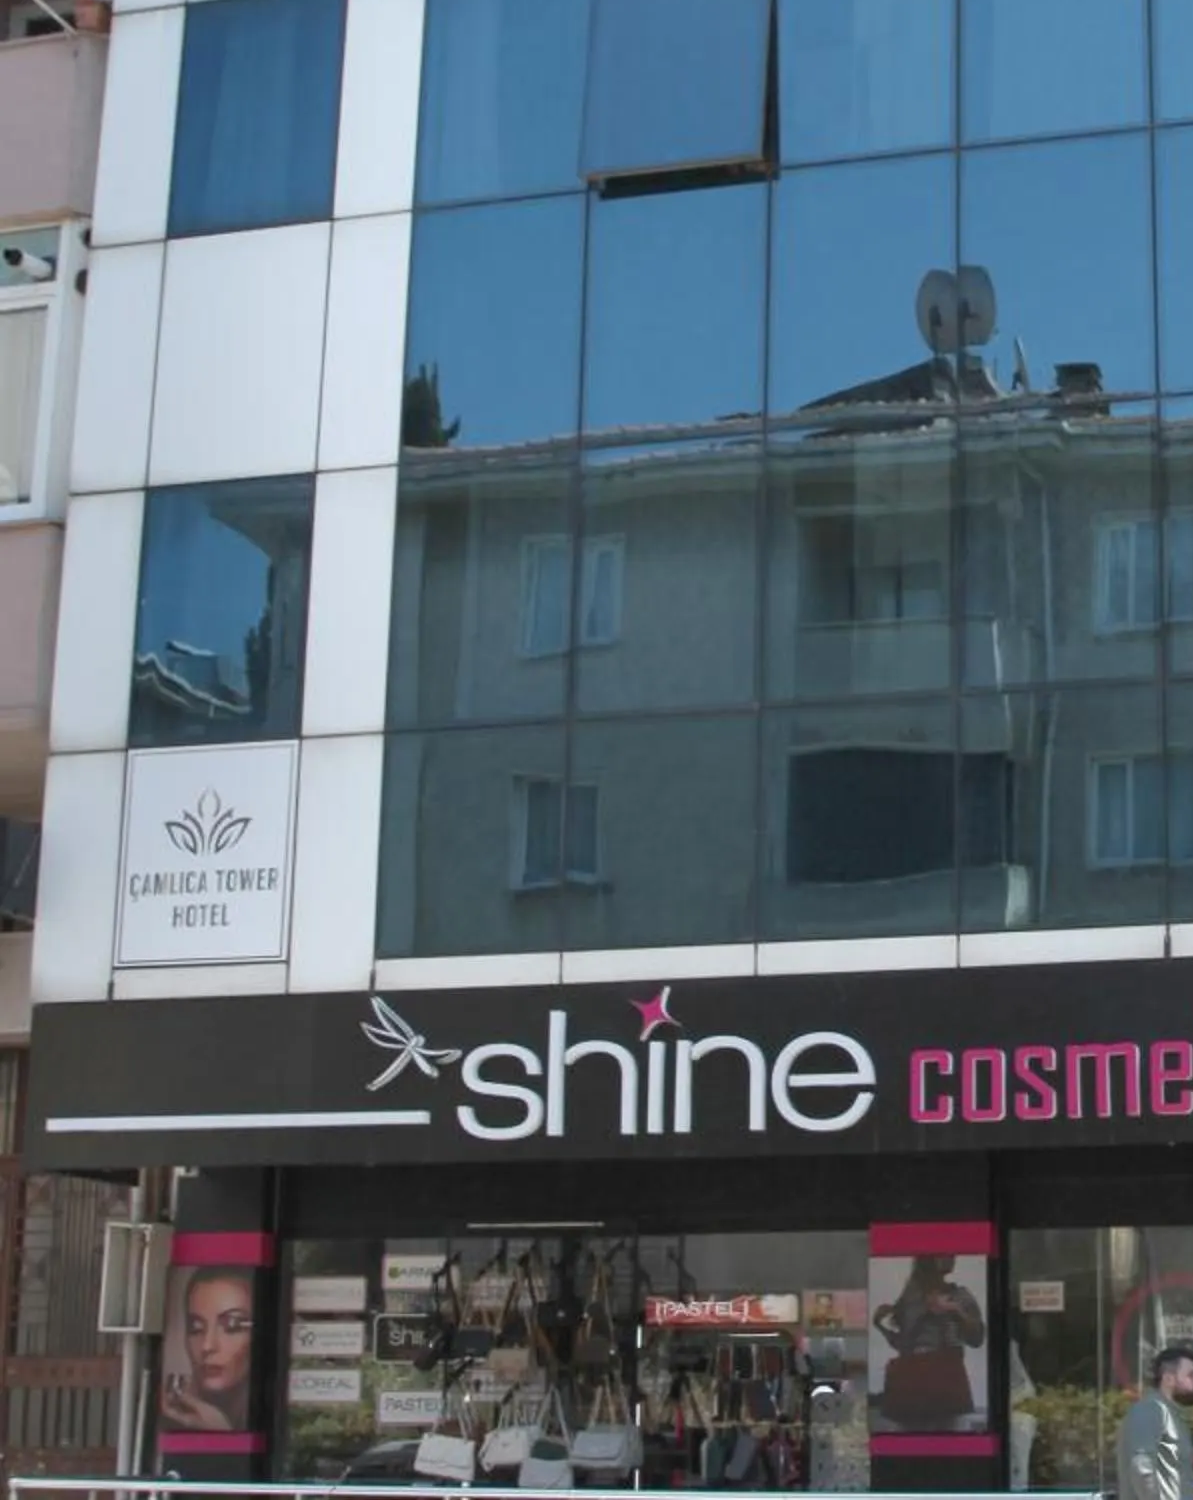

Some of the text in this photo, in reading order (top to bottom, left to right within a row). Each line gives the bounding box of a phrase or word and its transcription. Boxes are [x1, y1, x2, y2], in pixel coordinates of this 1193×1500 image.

[129, 867, 279, 902] ÇAMLICA TOWER
[172, 902, 230, 928] HOTEL
[456, 986, 877, 1141] shine
